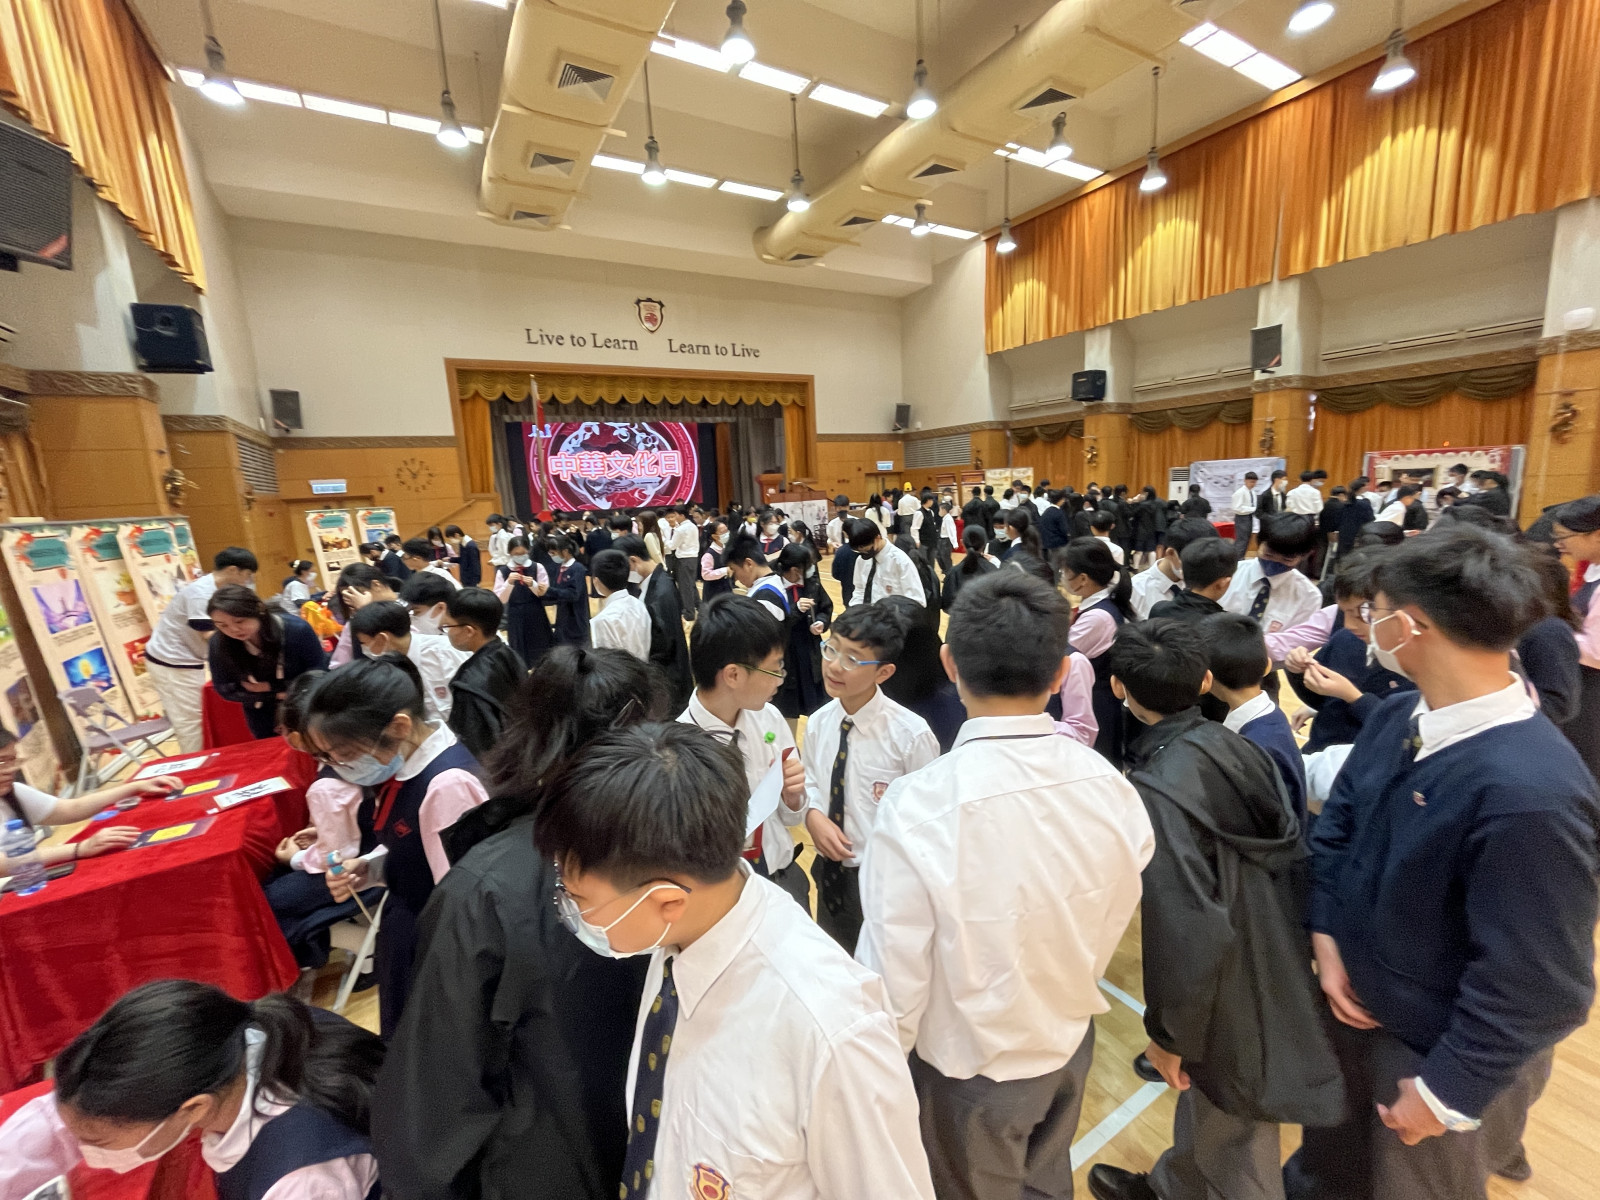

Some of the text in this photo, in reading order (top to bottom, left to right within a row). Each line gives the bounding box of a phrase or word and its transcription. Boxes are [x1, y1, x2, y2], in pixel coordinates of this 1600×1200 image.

[525, 328, 639, 351] Live to Learn
[667, 338, 760, 358] Learn to Live
[549, 451, 682, 481] 中華文化日
